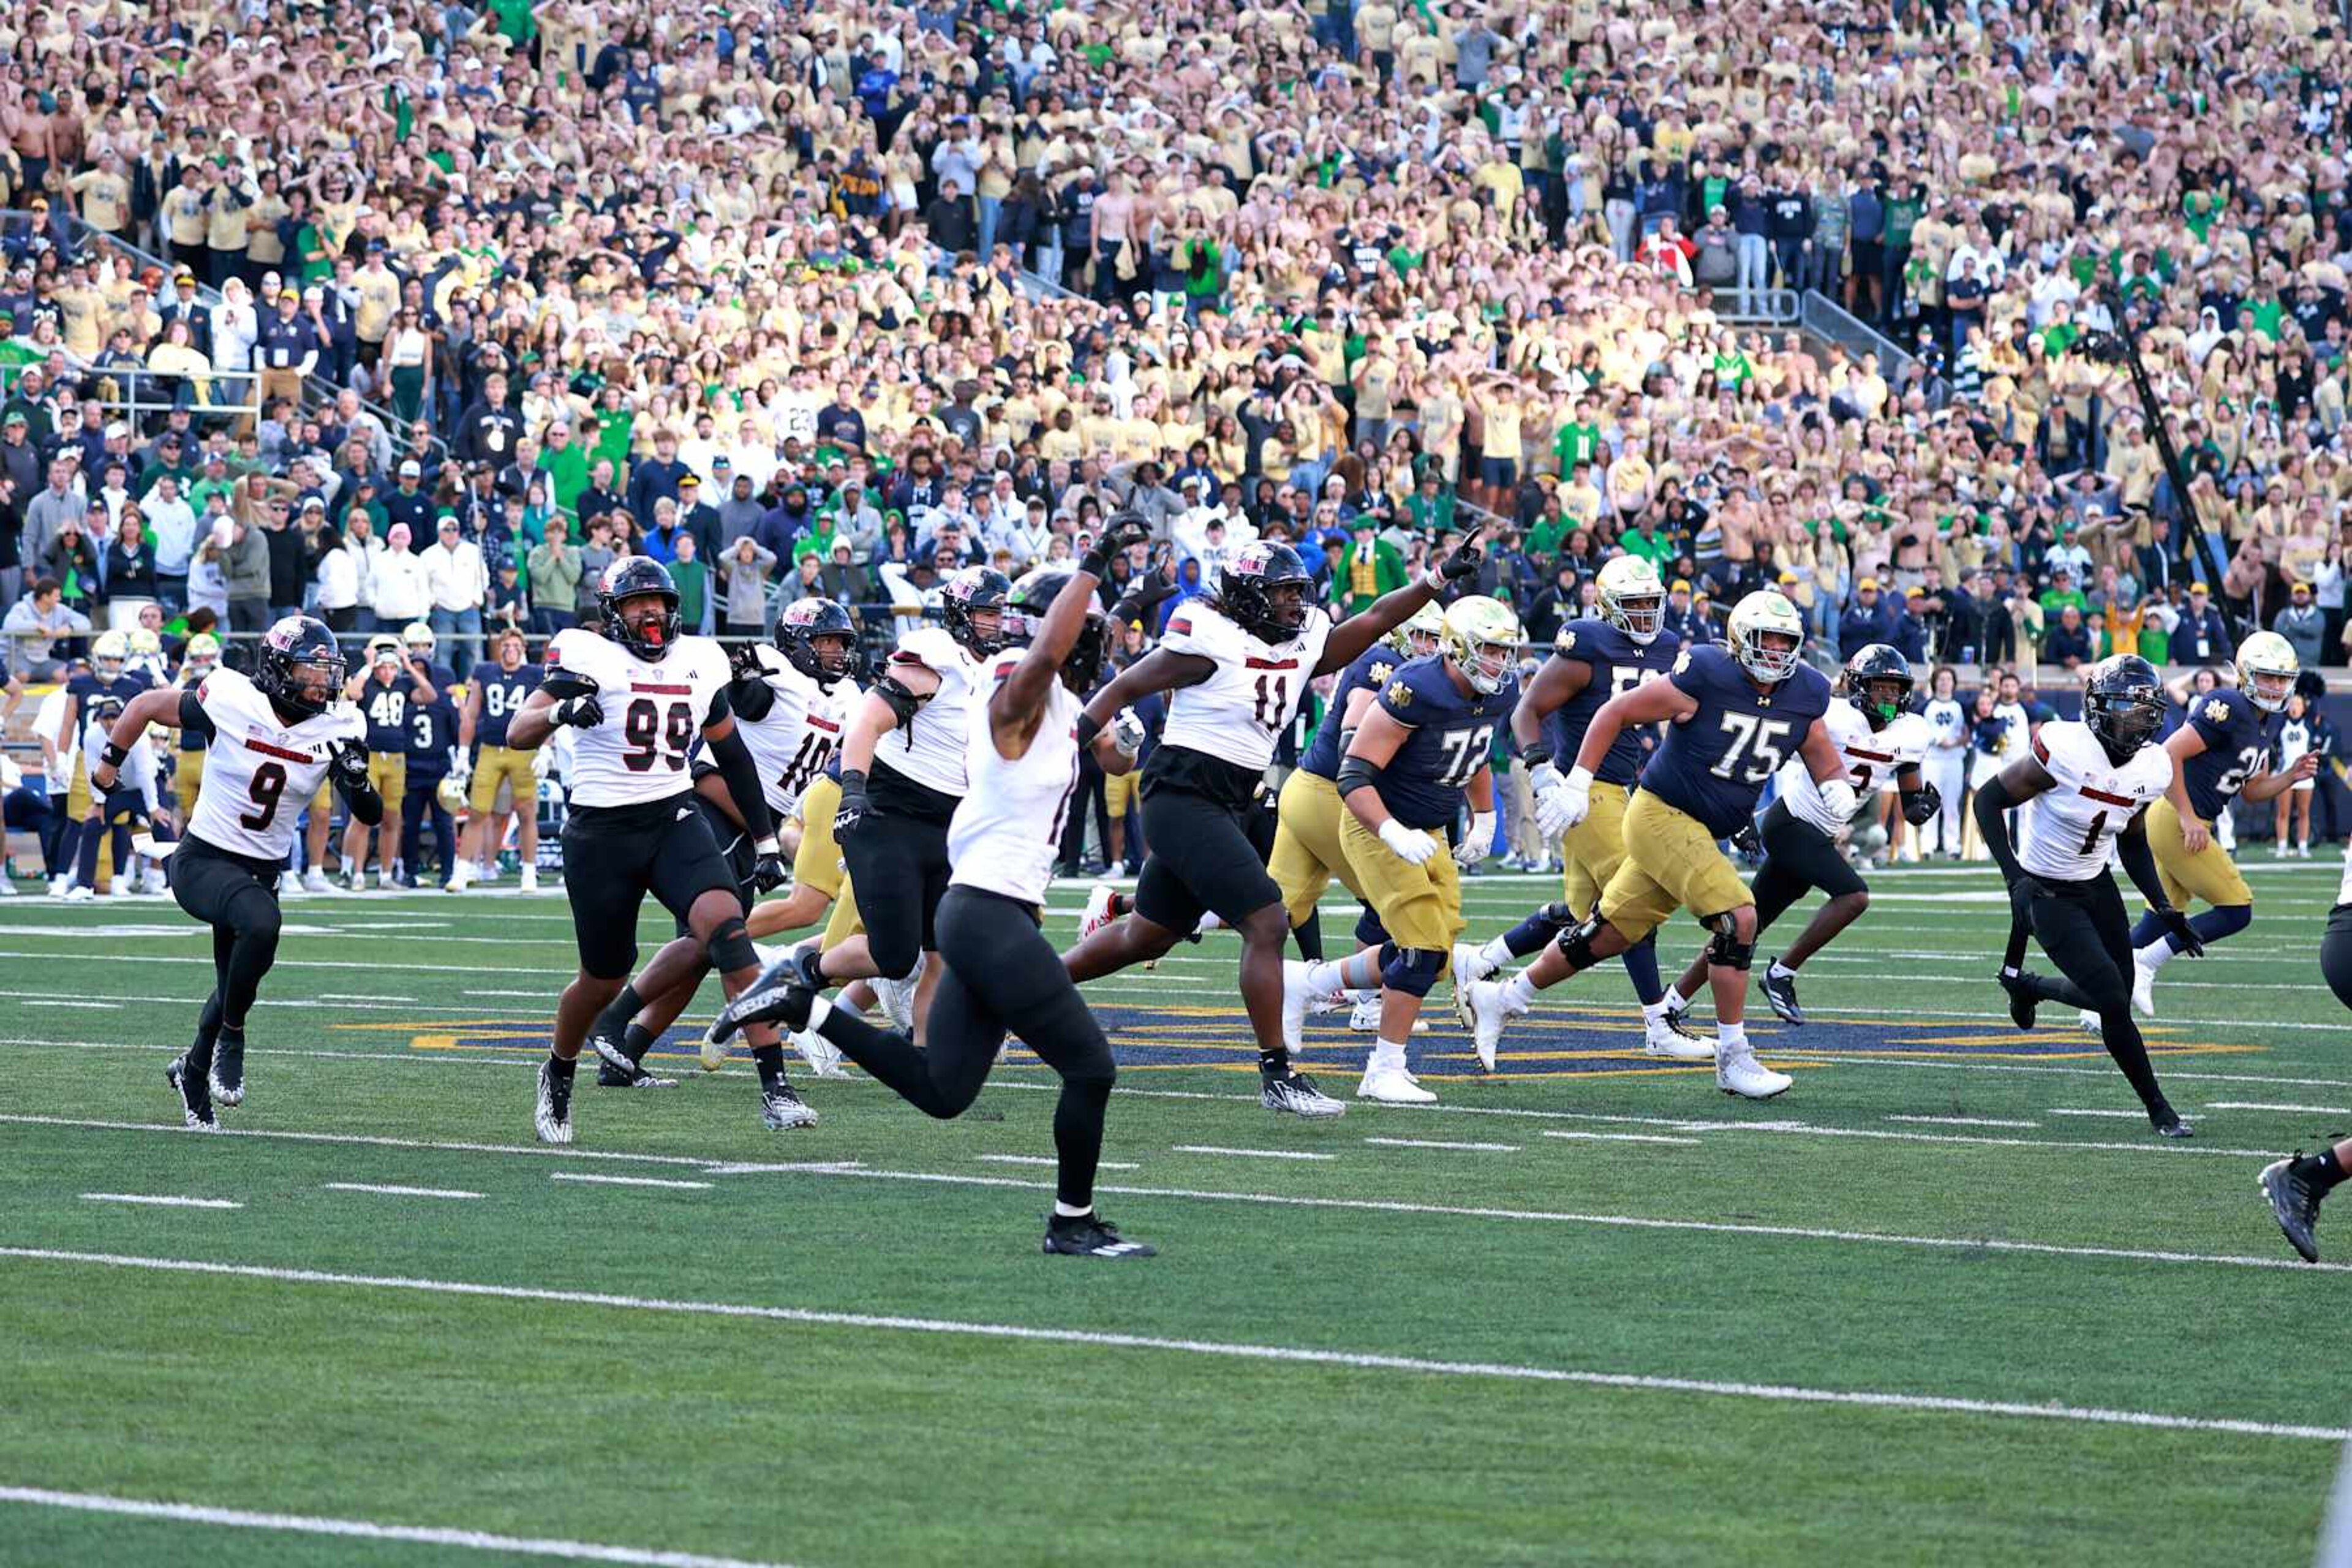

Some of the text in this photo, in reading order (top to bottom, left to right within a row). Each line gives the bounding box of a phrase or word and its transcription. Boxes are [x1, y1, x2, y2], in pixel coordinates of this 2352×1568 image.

[369, 692, 405, 727] 48
[486, 685, 526, 717] 84
[1254, 674, 1287, 733] 11
[412, 715, 432, 749] 3
[623, 698, 693, 772] 99
[1432, 725, 1494, 790] 72
[1710, 712, 1792, 783] 75
[240, 761, 288, 832] 9
[2078, 810, 2109, 856] 1
